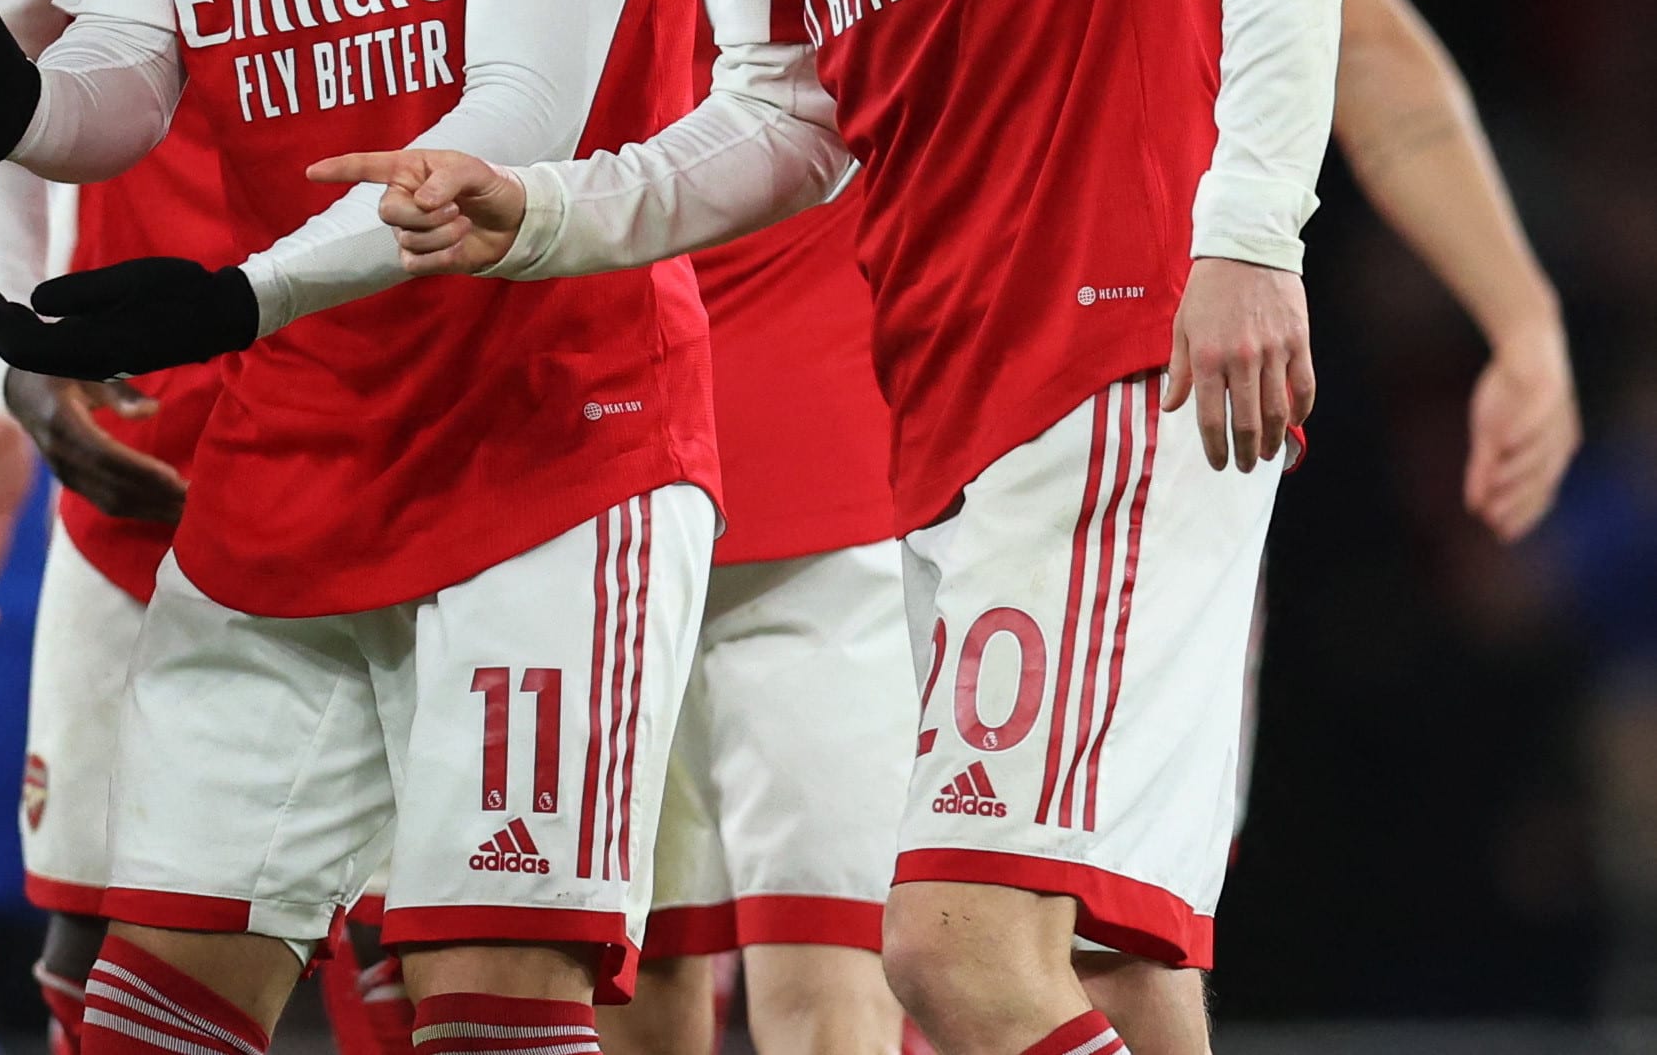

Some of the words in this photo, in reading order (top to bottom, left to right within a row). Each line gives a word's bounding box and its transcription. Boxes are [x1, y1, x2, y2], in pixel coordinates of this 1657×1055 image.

[234, 47, 300, 123] FLY
[313, 19, 455, 111] BETTER
[470, 667, 562, 814] 11
[932, 795, 1007, 818] adidas
[469, 851, 550, 875] adidas
